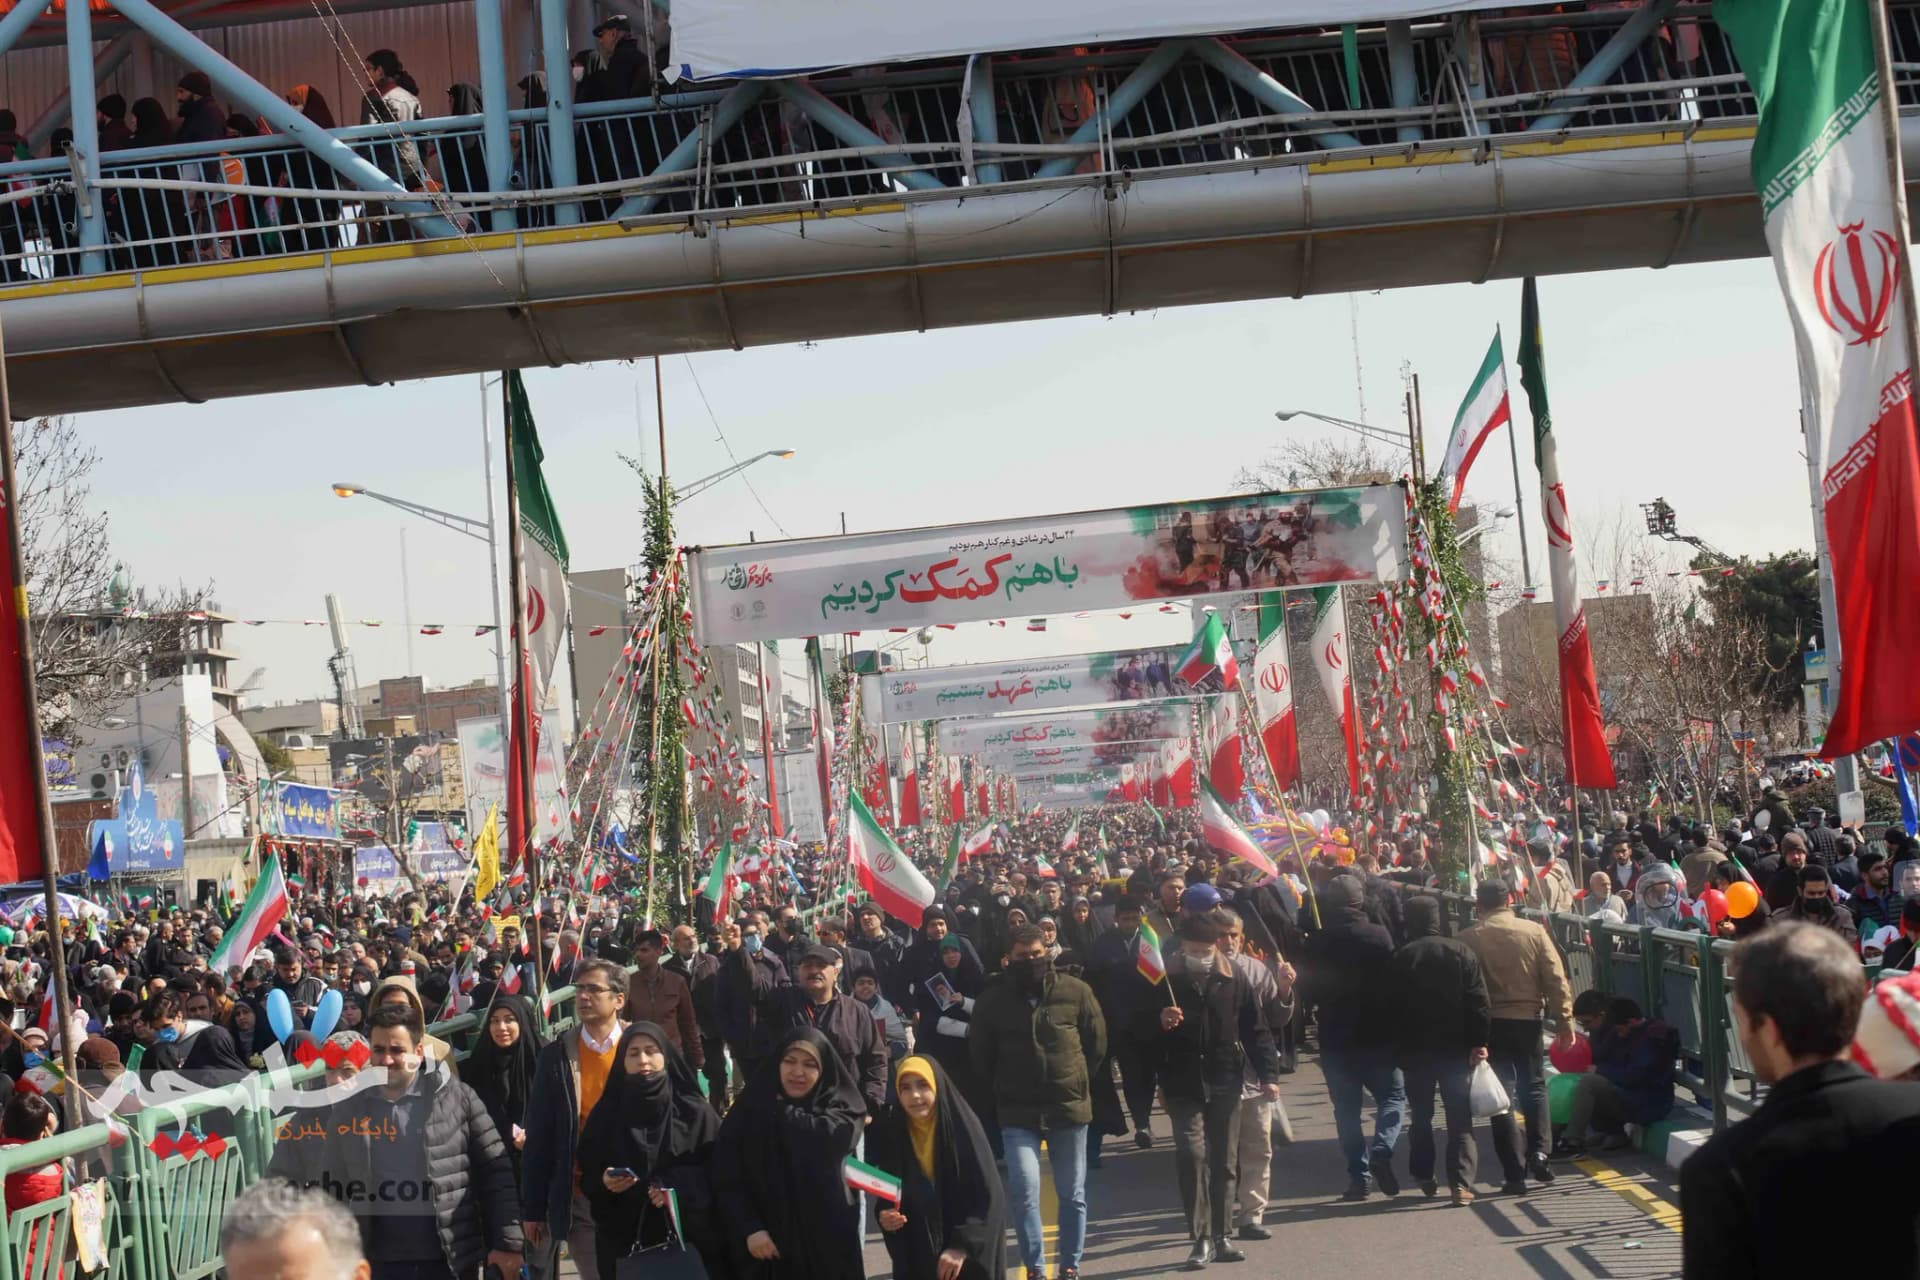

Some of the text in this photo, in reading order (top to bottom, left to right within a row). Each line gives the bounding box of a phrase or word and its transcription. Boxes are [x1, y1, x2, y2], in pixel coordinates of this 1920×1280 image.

[821, 569, 906, 620] کردیم
[899, 552, 1013, 604] کمک
[936, 683, 986, 707] بستیم
[987, 674, 1035, 705] عهد
